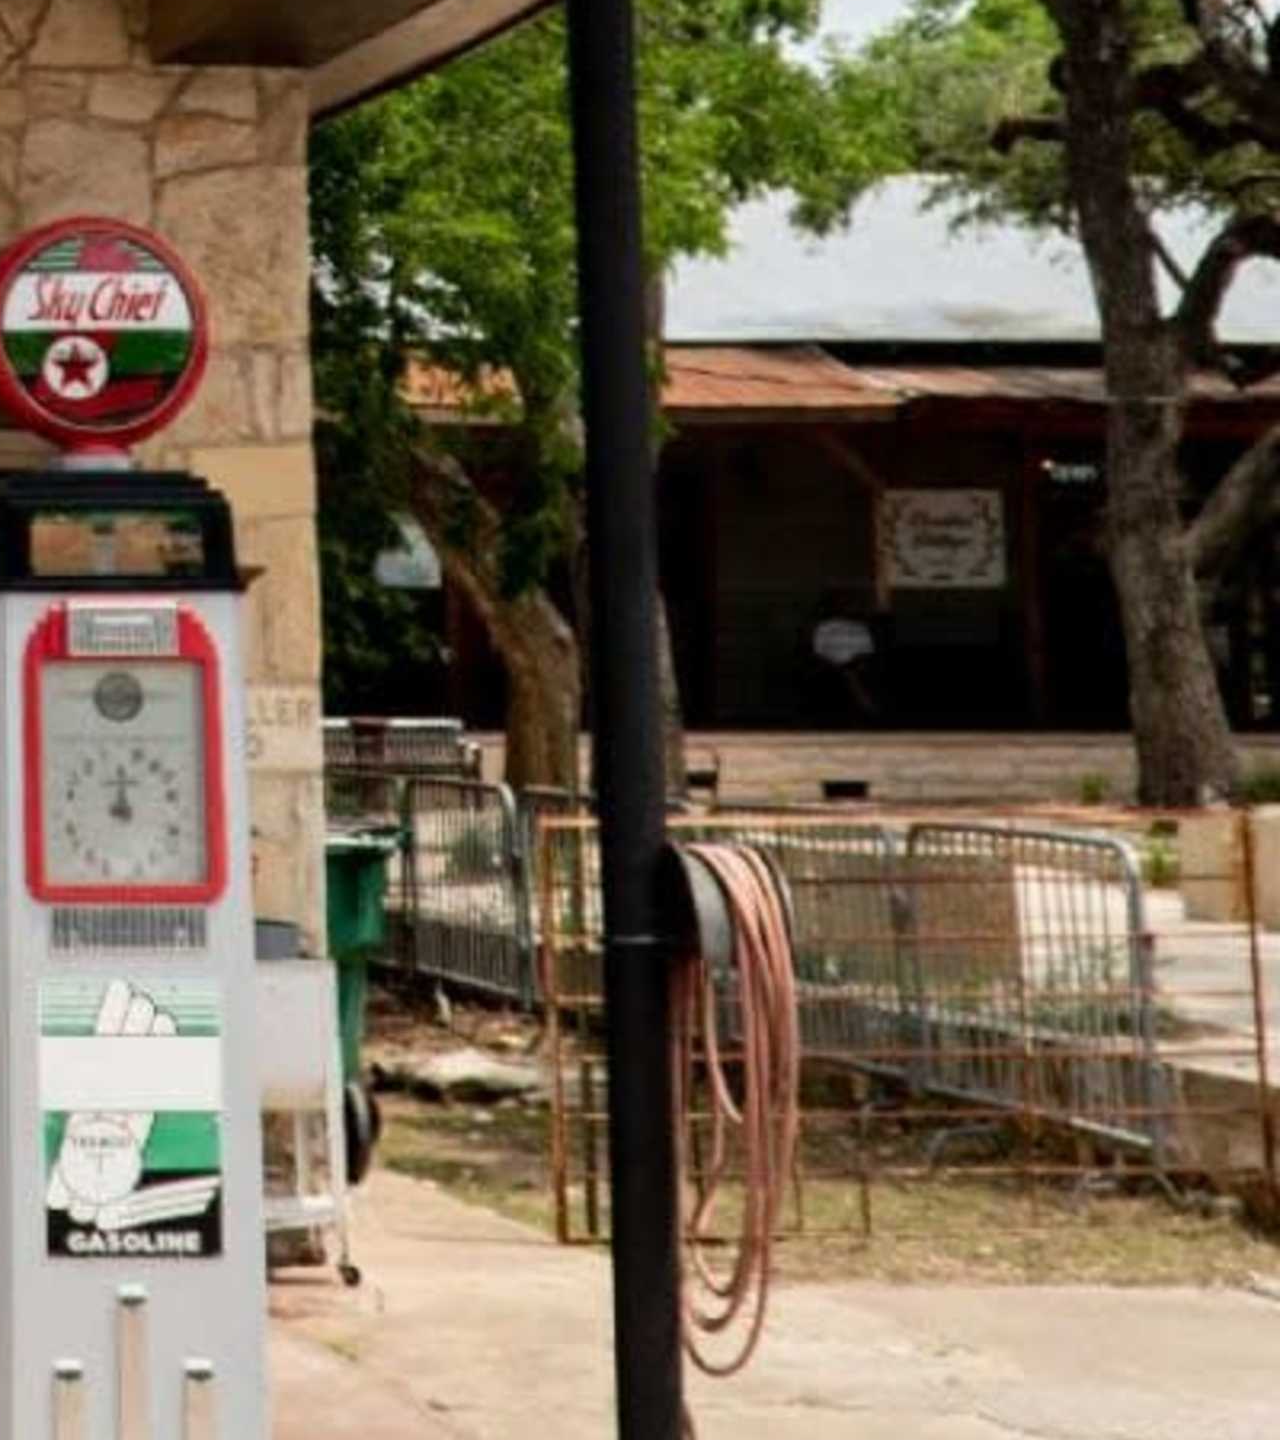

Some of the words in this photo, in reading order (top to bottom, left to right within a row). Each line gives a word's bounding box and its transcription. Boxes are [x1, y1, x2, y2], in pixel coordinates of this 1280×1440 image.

[27, 273, 84, 326] Sky
[89, 276, 170, 322] Chief
[65, 1230, 203, 1253] GASOLINE
